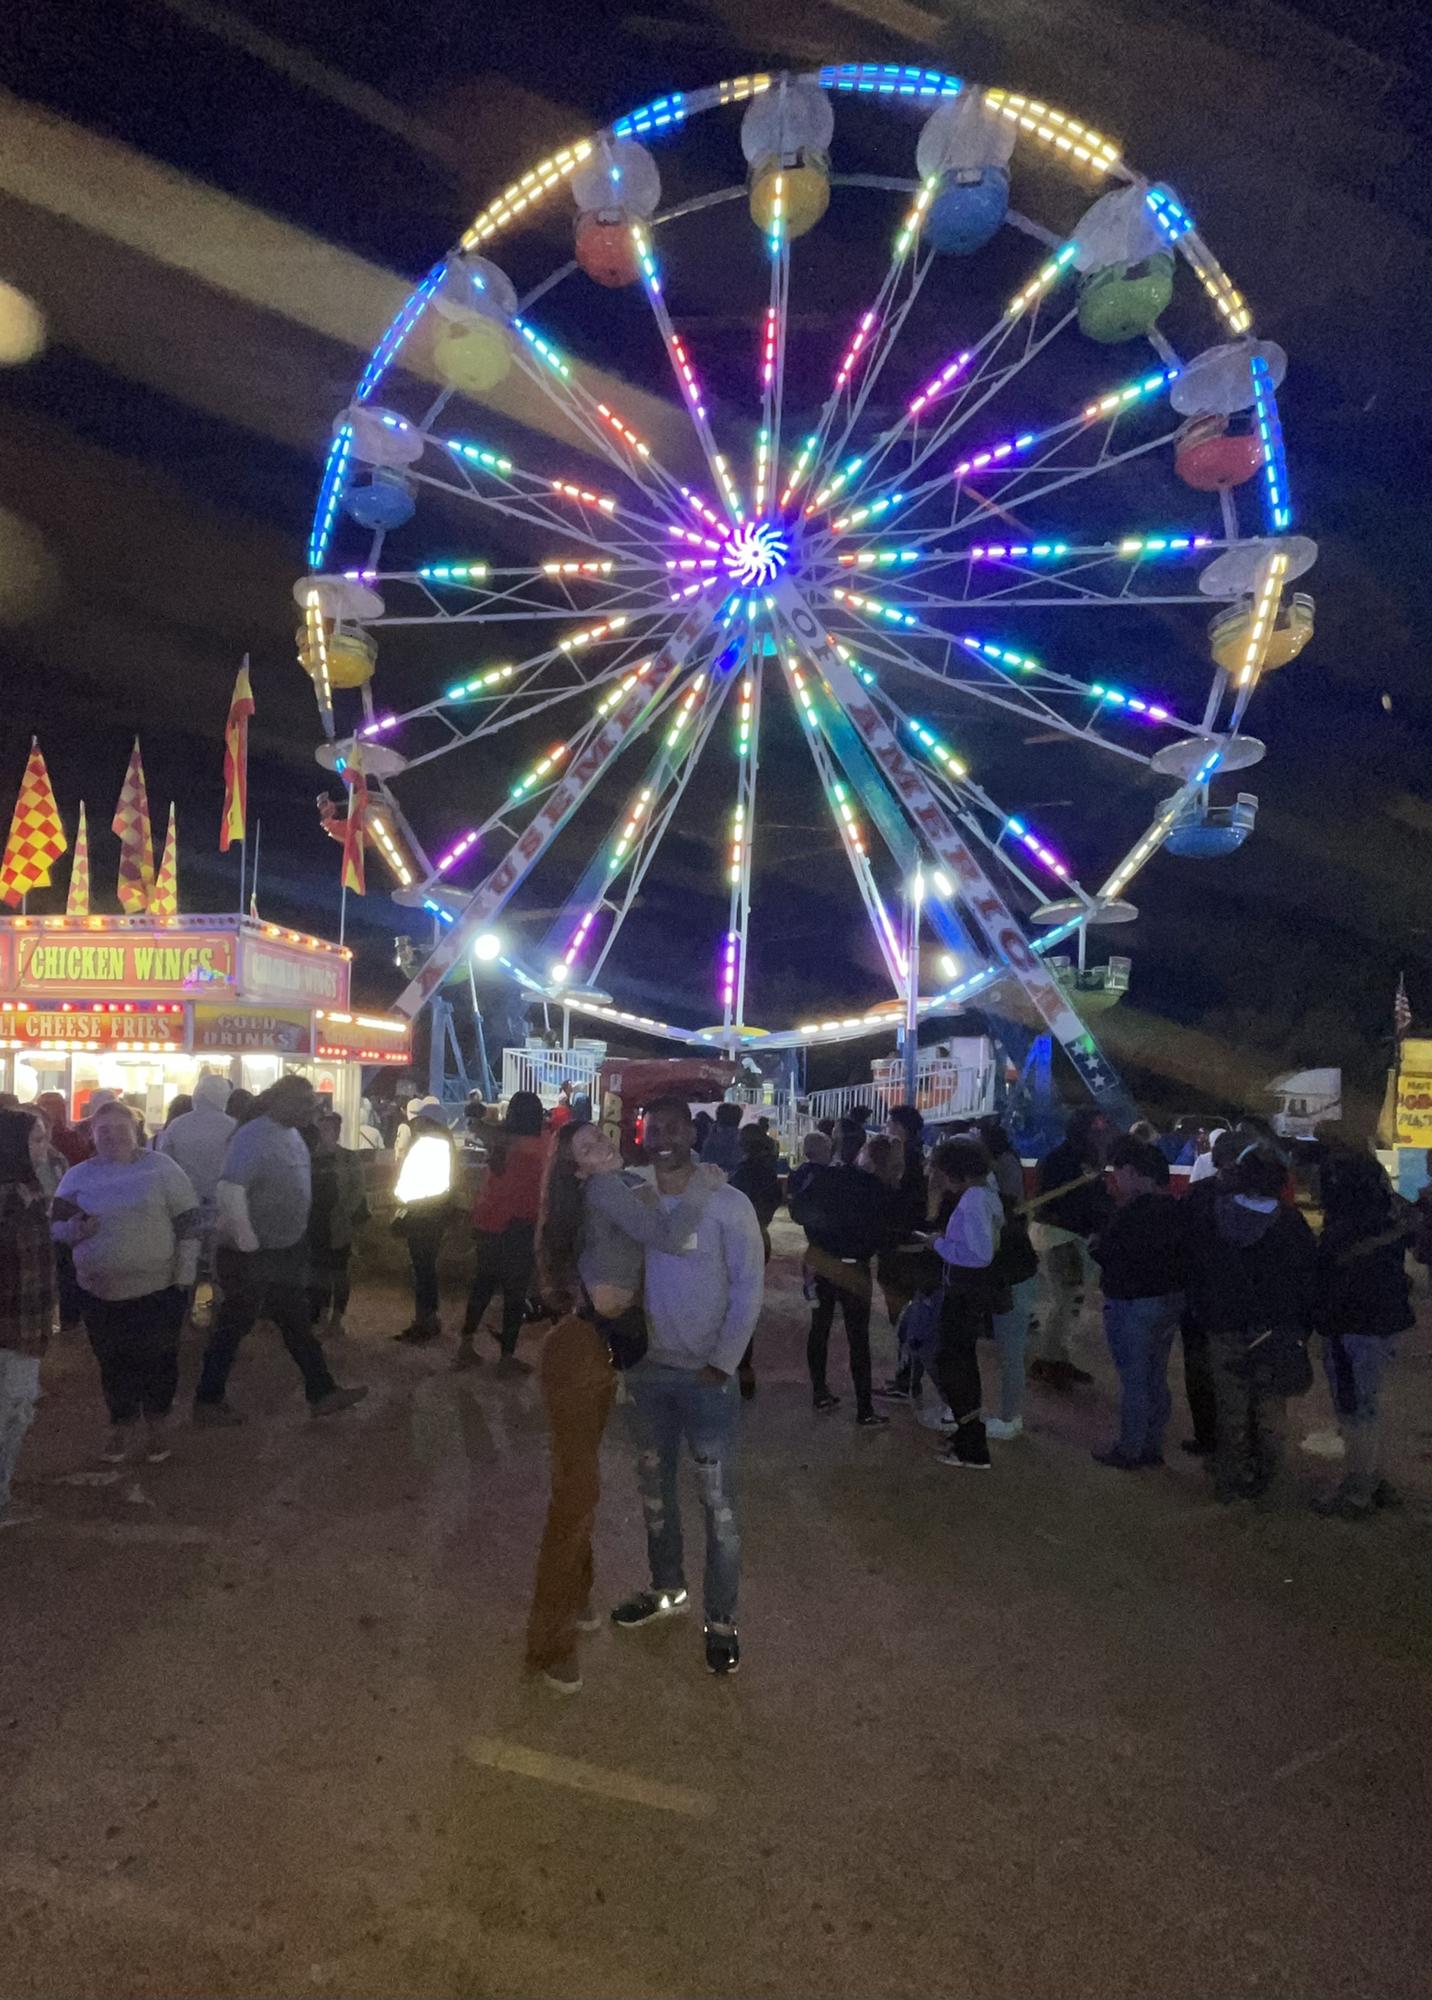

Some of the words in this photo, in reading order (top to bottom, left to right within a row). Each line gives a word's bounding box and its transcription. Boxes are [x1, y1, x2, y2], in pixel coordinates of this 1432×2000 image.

[848, 702, 1066, 1025] AMERICA
[30, 945, 125, 981] CHICKEN
[134, 946, 214, 982] WINGS
[25, 1015, 101, 1038] CHEESE
[110, 1016, 171, 1039] FRIES
[217, 1014, 278, 1031] COLD
[203, 1030, 290, 1047] DRINKS
